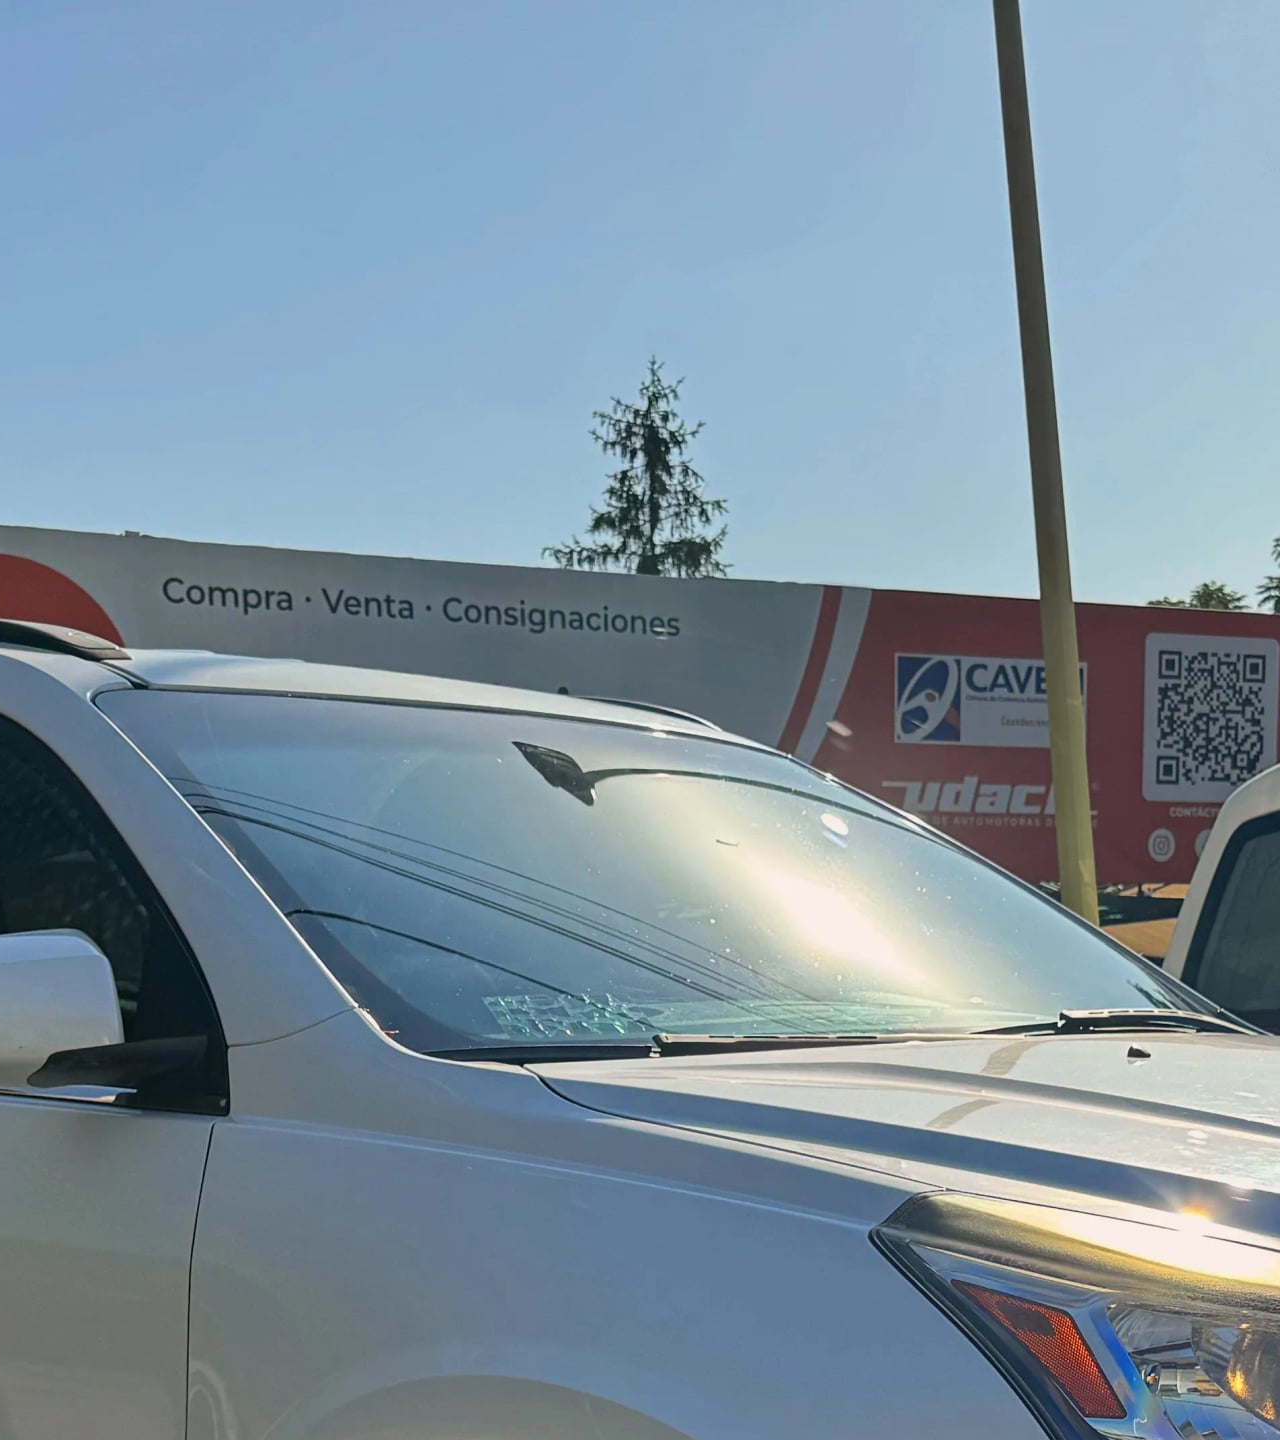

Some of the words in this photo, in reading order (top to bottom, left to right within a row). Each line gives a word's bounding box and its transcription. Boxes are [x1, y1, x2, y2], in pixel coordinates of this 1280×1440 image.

[161, 577, 294, 615] Compra
[321, 588, 415, 620] Venta
[442, 598, 681, 637] Consignaciones
[965, 663, 1084, 695] CAVE
